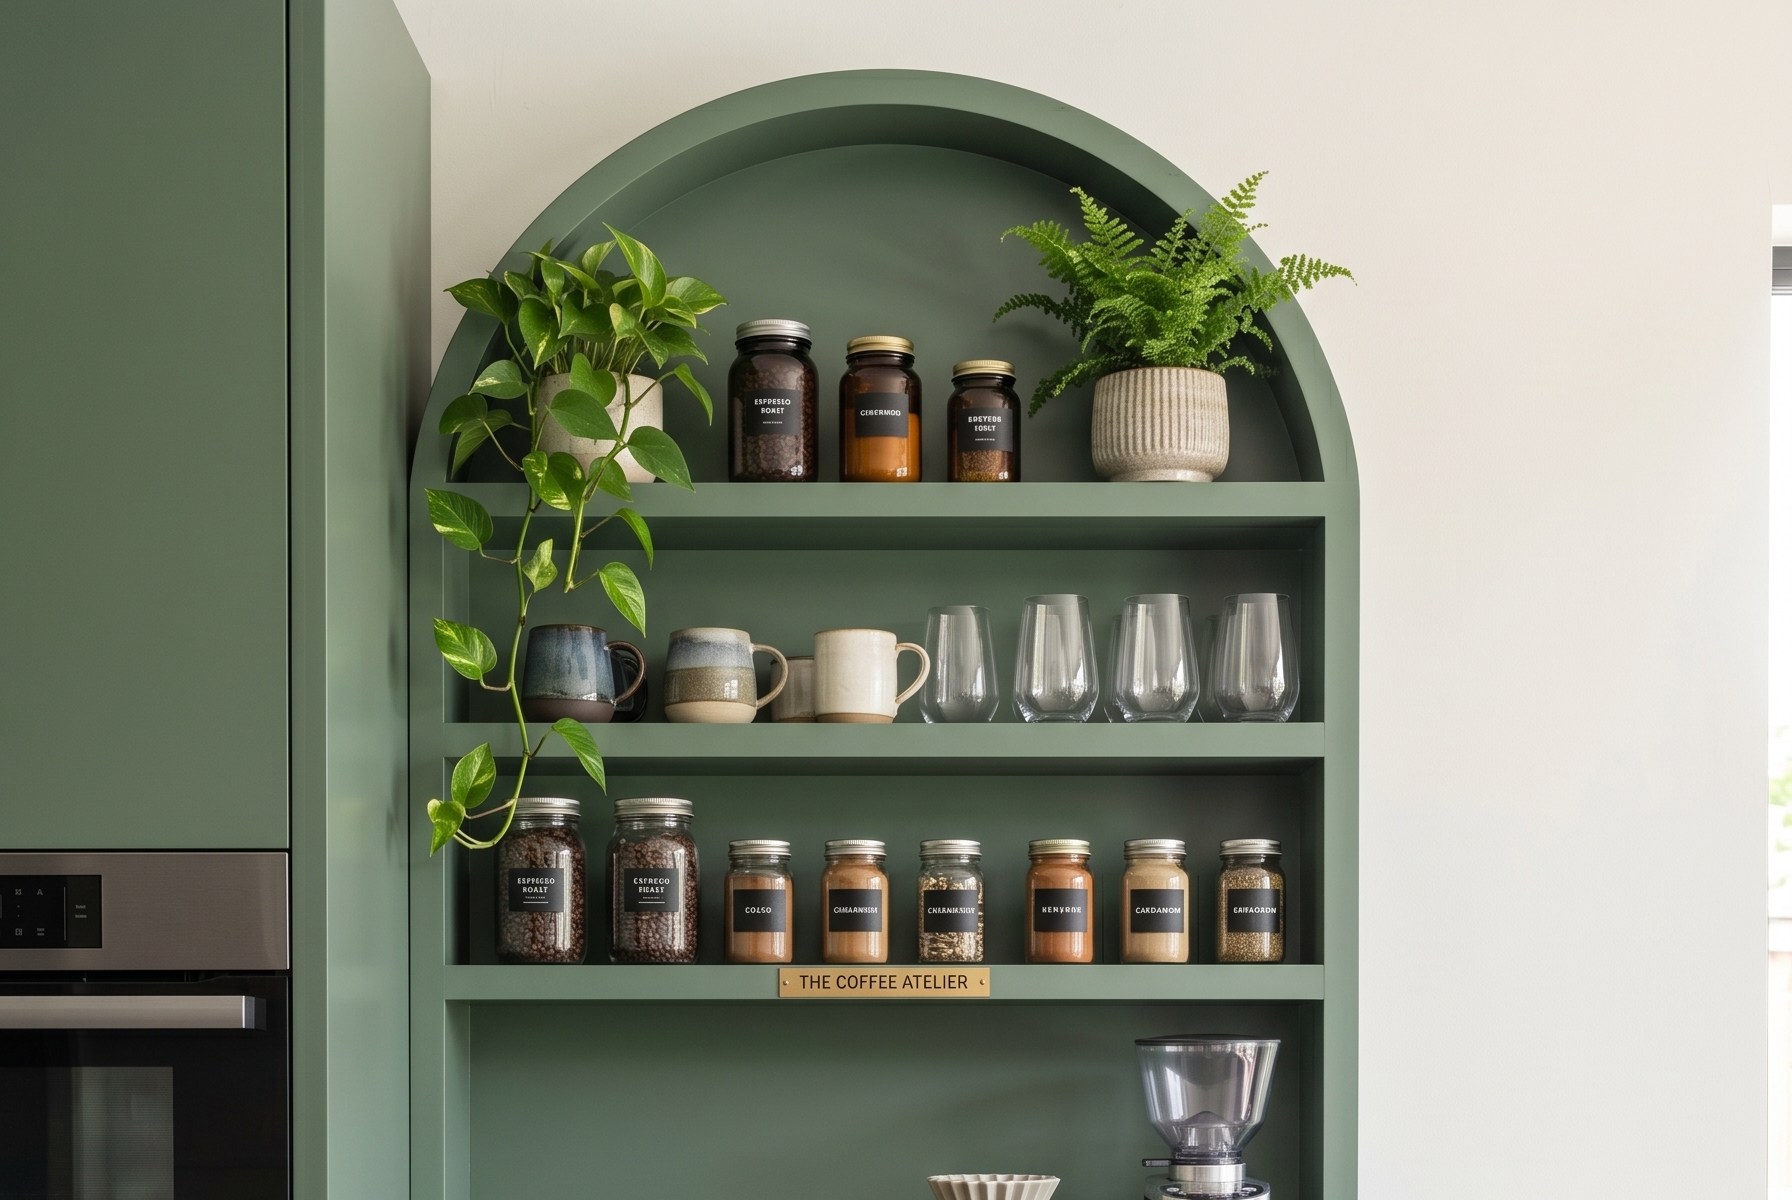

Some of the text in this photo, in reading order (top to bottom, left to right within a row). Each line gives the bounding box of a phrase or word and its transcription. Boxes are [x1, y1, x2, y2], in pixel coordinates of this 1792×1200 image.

[799, 975, 968, 989] THE COFFEE ATELIER
